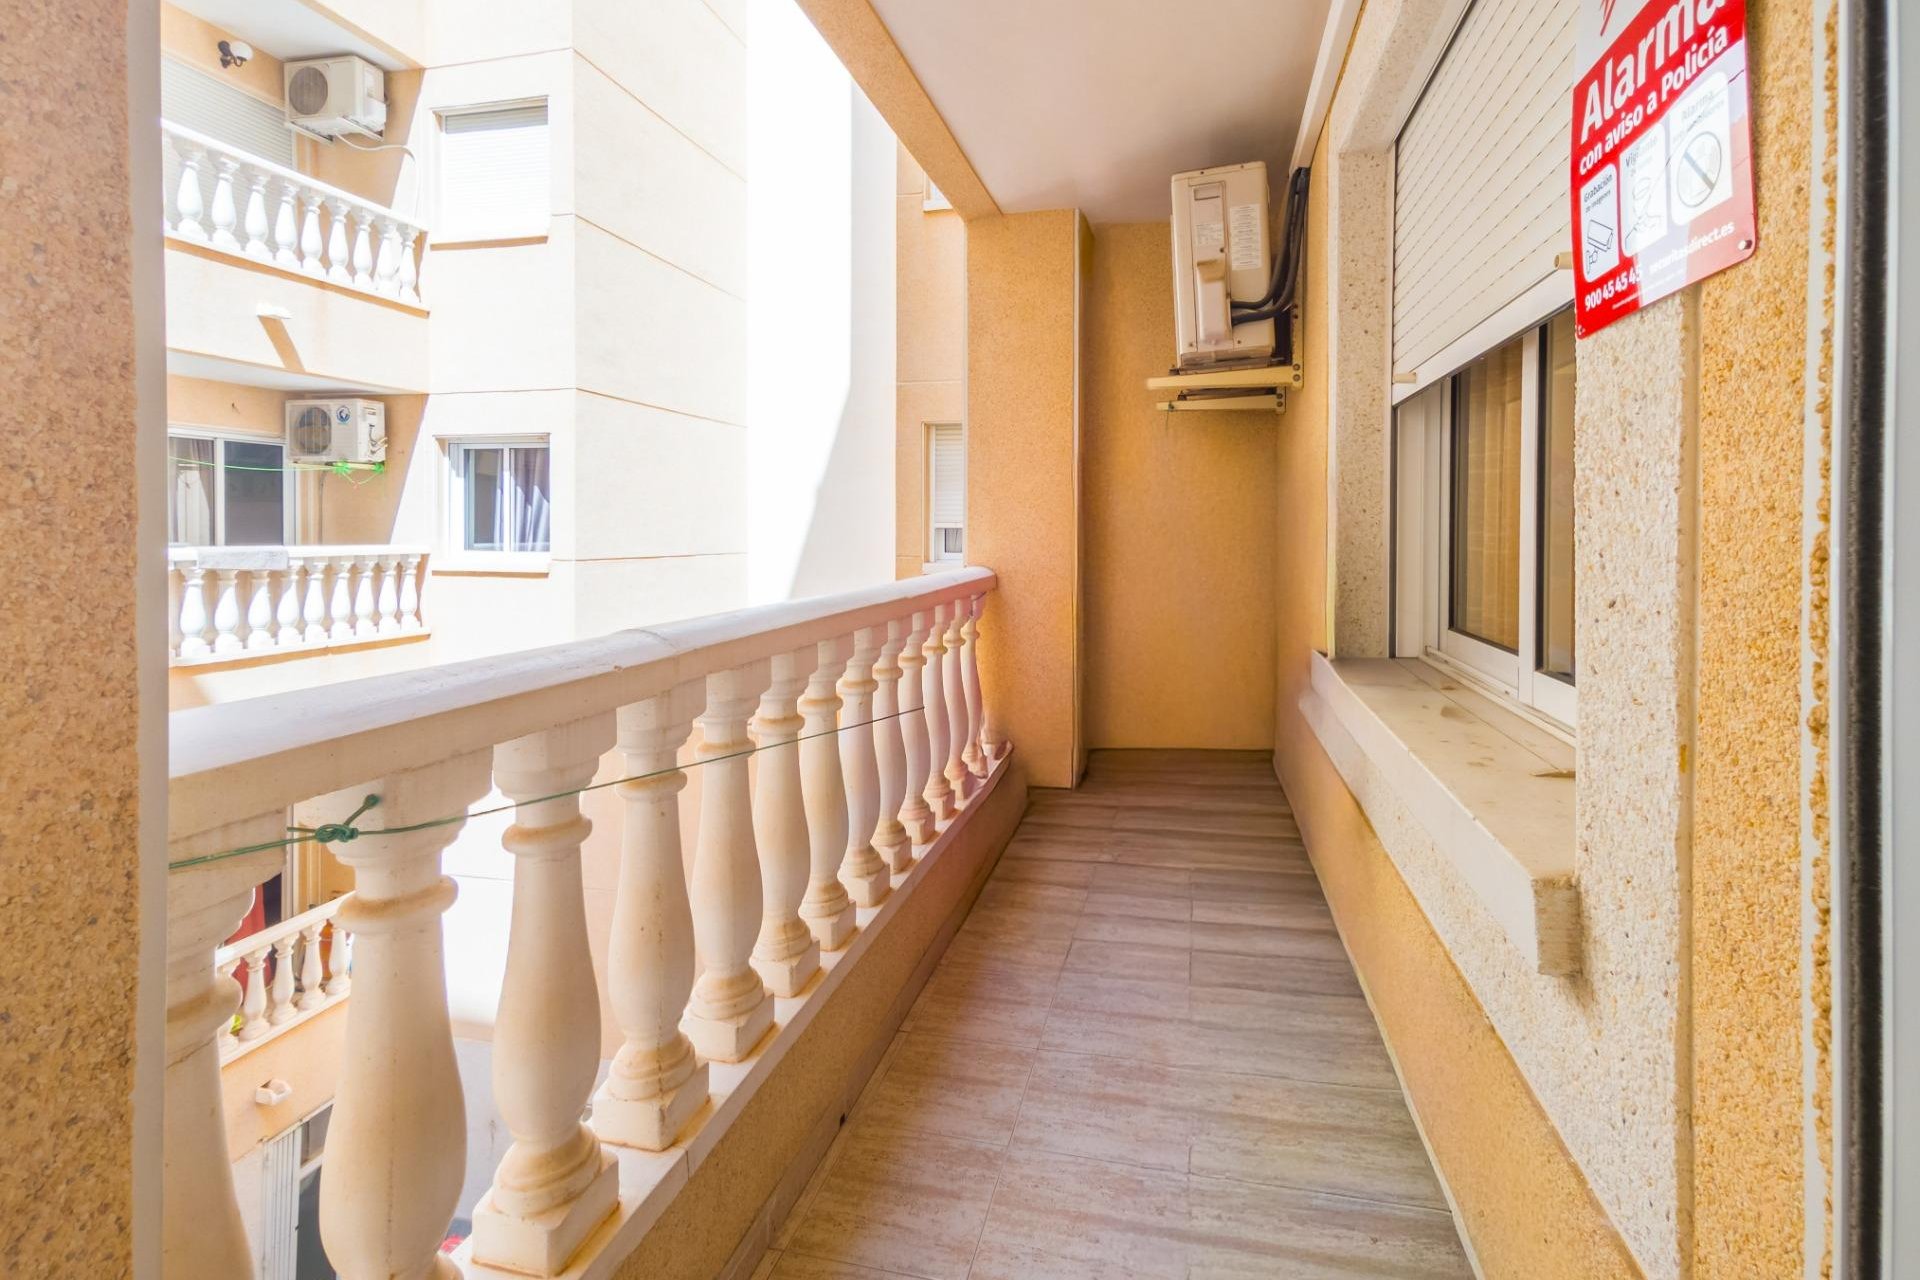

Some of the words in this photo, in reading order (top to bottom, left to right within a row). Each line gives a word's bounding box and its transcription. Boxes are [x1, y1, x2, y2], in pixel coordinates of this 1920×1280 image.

[1579, 142, 1602, 175] con
[1605, 104, 1643, 153] aviso
[1646, 91, 1657, 115] a
[1661, 25, 1727, 102] Policía
[1585, 288, 1601, 312] 900
[1602, 281, 1615, 301] 45
[1615, 273, 1628, 294] 45
